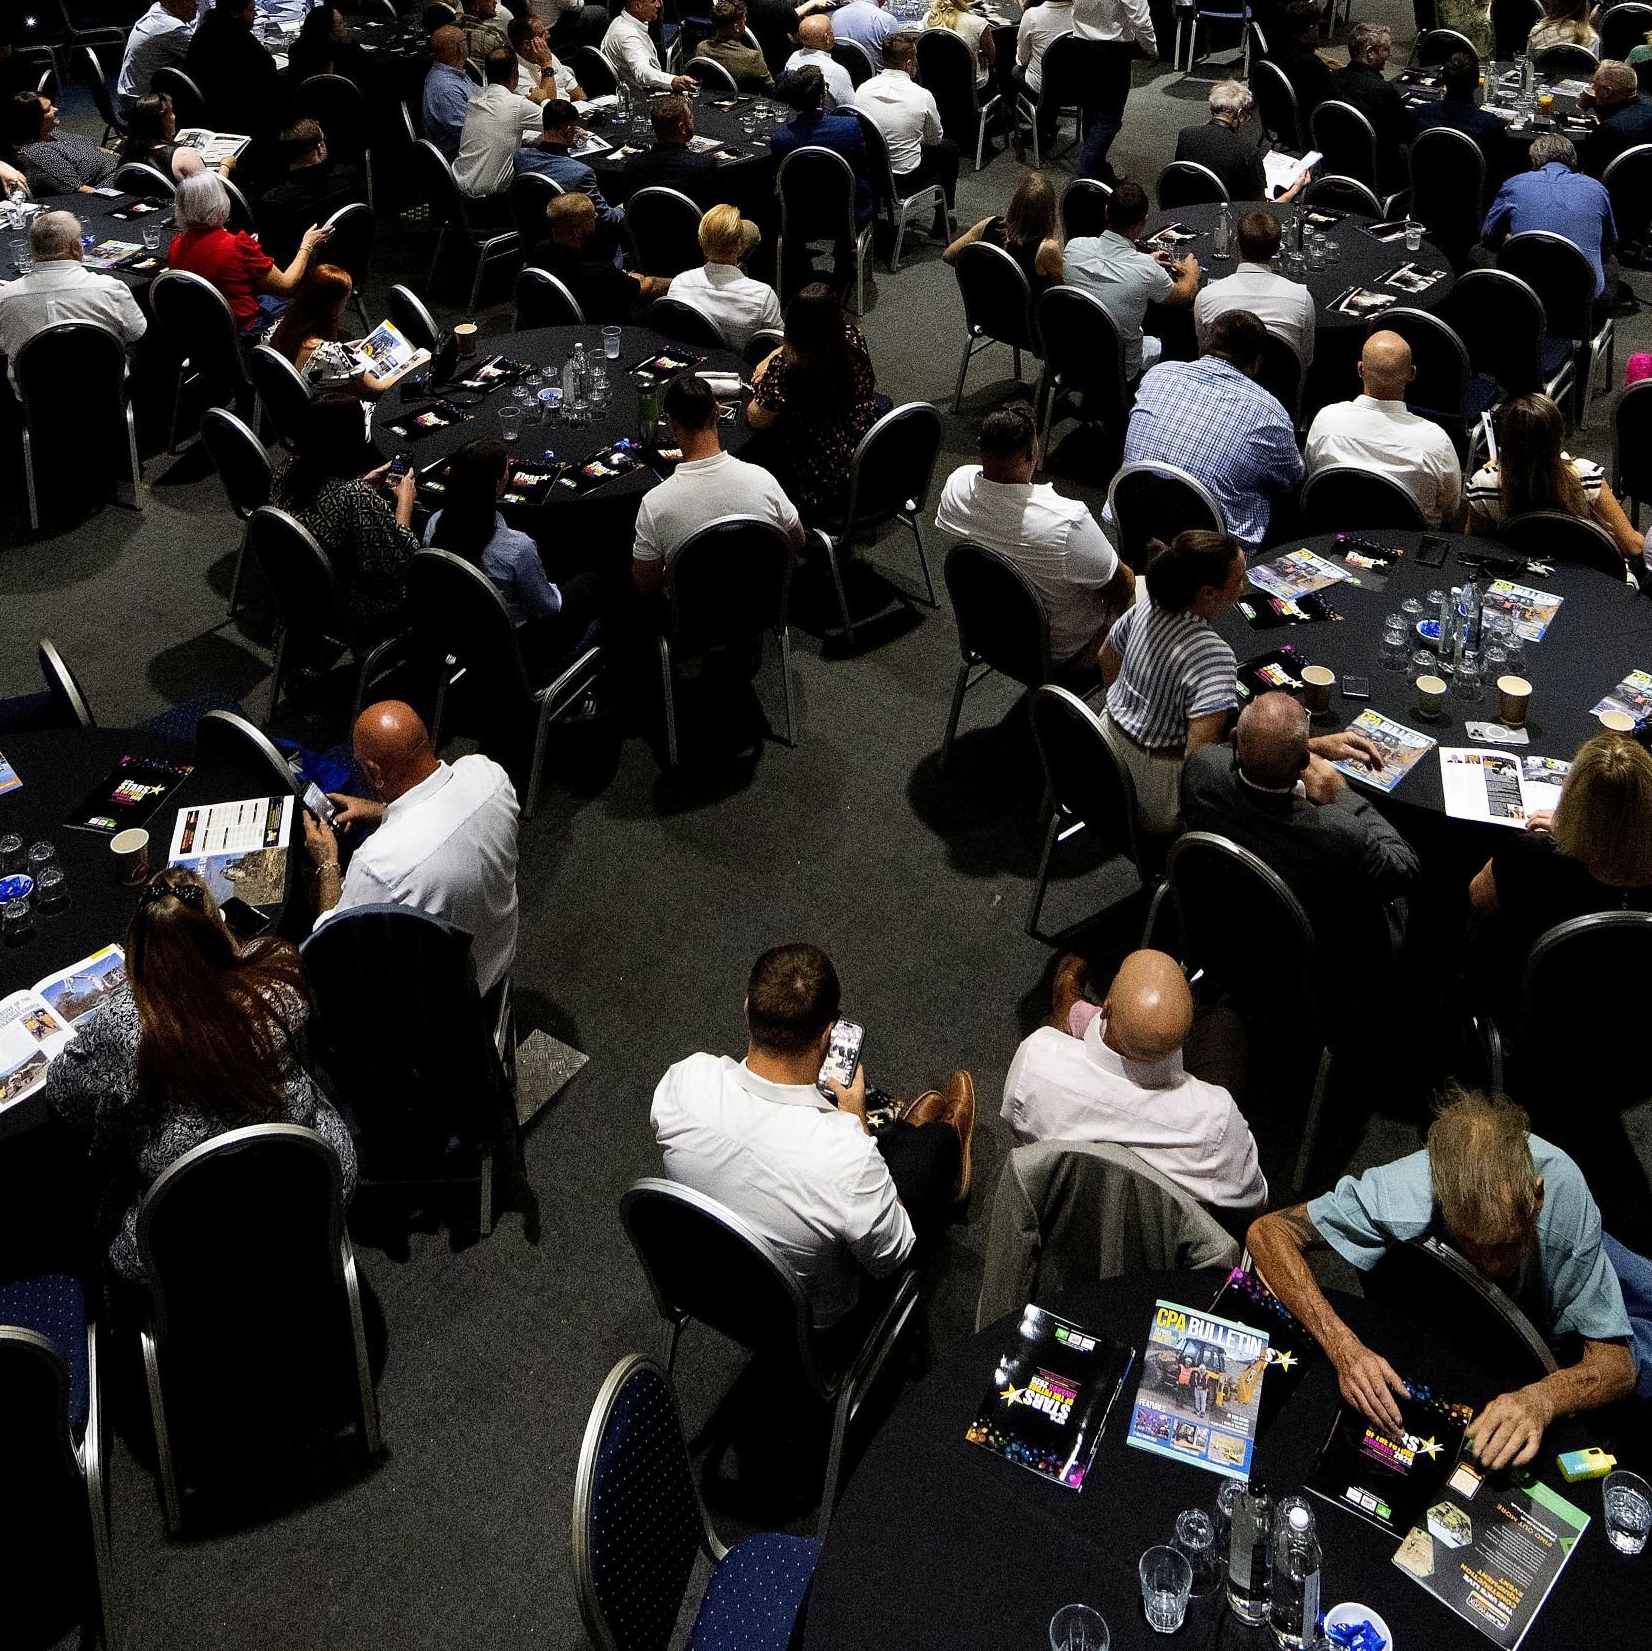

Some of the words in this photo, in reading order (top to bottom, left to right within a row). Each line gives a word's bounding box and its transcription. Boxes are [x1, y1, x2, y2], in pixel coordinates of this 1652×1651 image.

[0, 1013, 22, 1030] TRAINING
[1156, 1307, 1187, 1333] CPA
[1188, 1316, 1263, 1355] BULLETIN
[1031, 1376, 1049, 1389] 2025
[1048, 1383, 1078, 1399] AWARDS
[1053, 1393, 1065, 1403] THE
[1022, 1389, 1071, 1422] STARS
[1138, 1398, 1167, 1413] FEATURES
[1393, 1451, 1413, 1466] 2025
[1496, 1503, 1518, 1523] MORE
[1518, 1521, 1534, 1534] OUT
[1534, 1532, 1553, 1548] FIND
[1460, 1563, 1517, 1609] CONSTRUCTION
[1463, 1574, 1480, 1591] LIVE
[1477, 1569, 1522, 1604] EQUIPMENT
[1498, 1577, 1524, 1598] EVENT
[1497, 1601, 1514, 1616] THE
